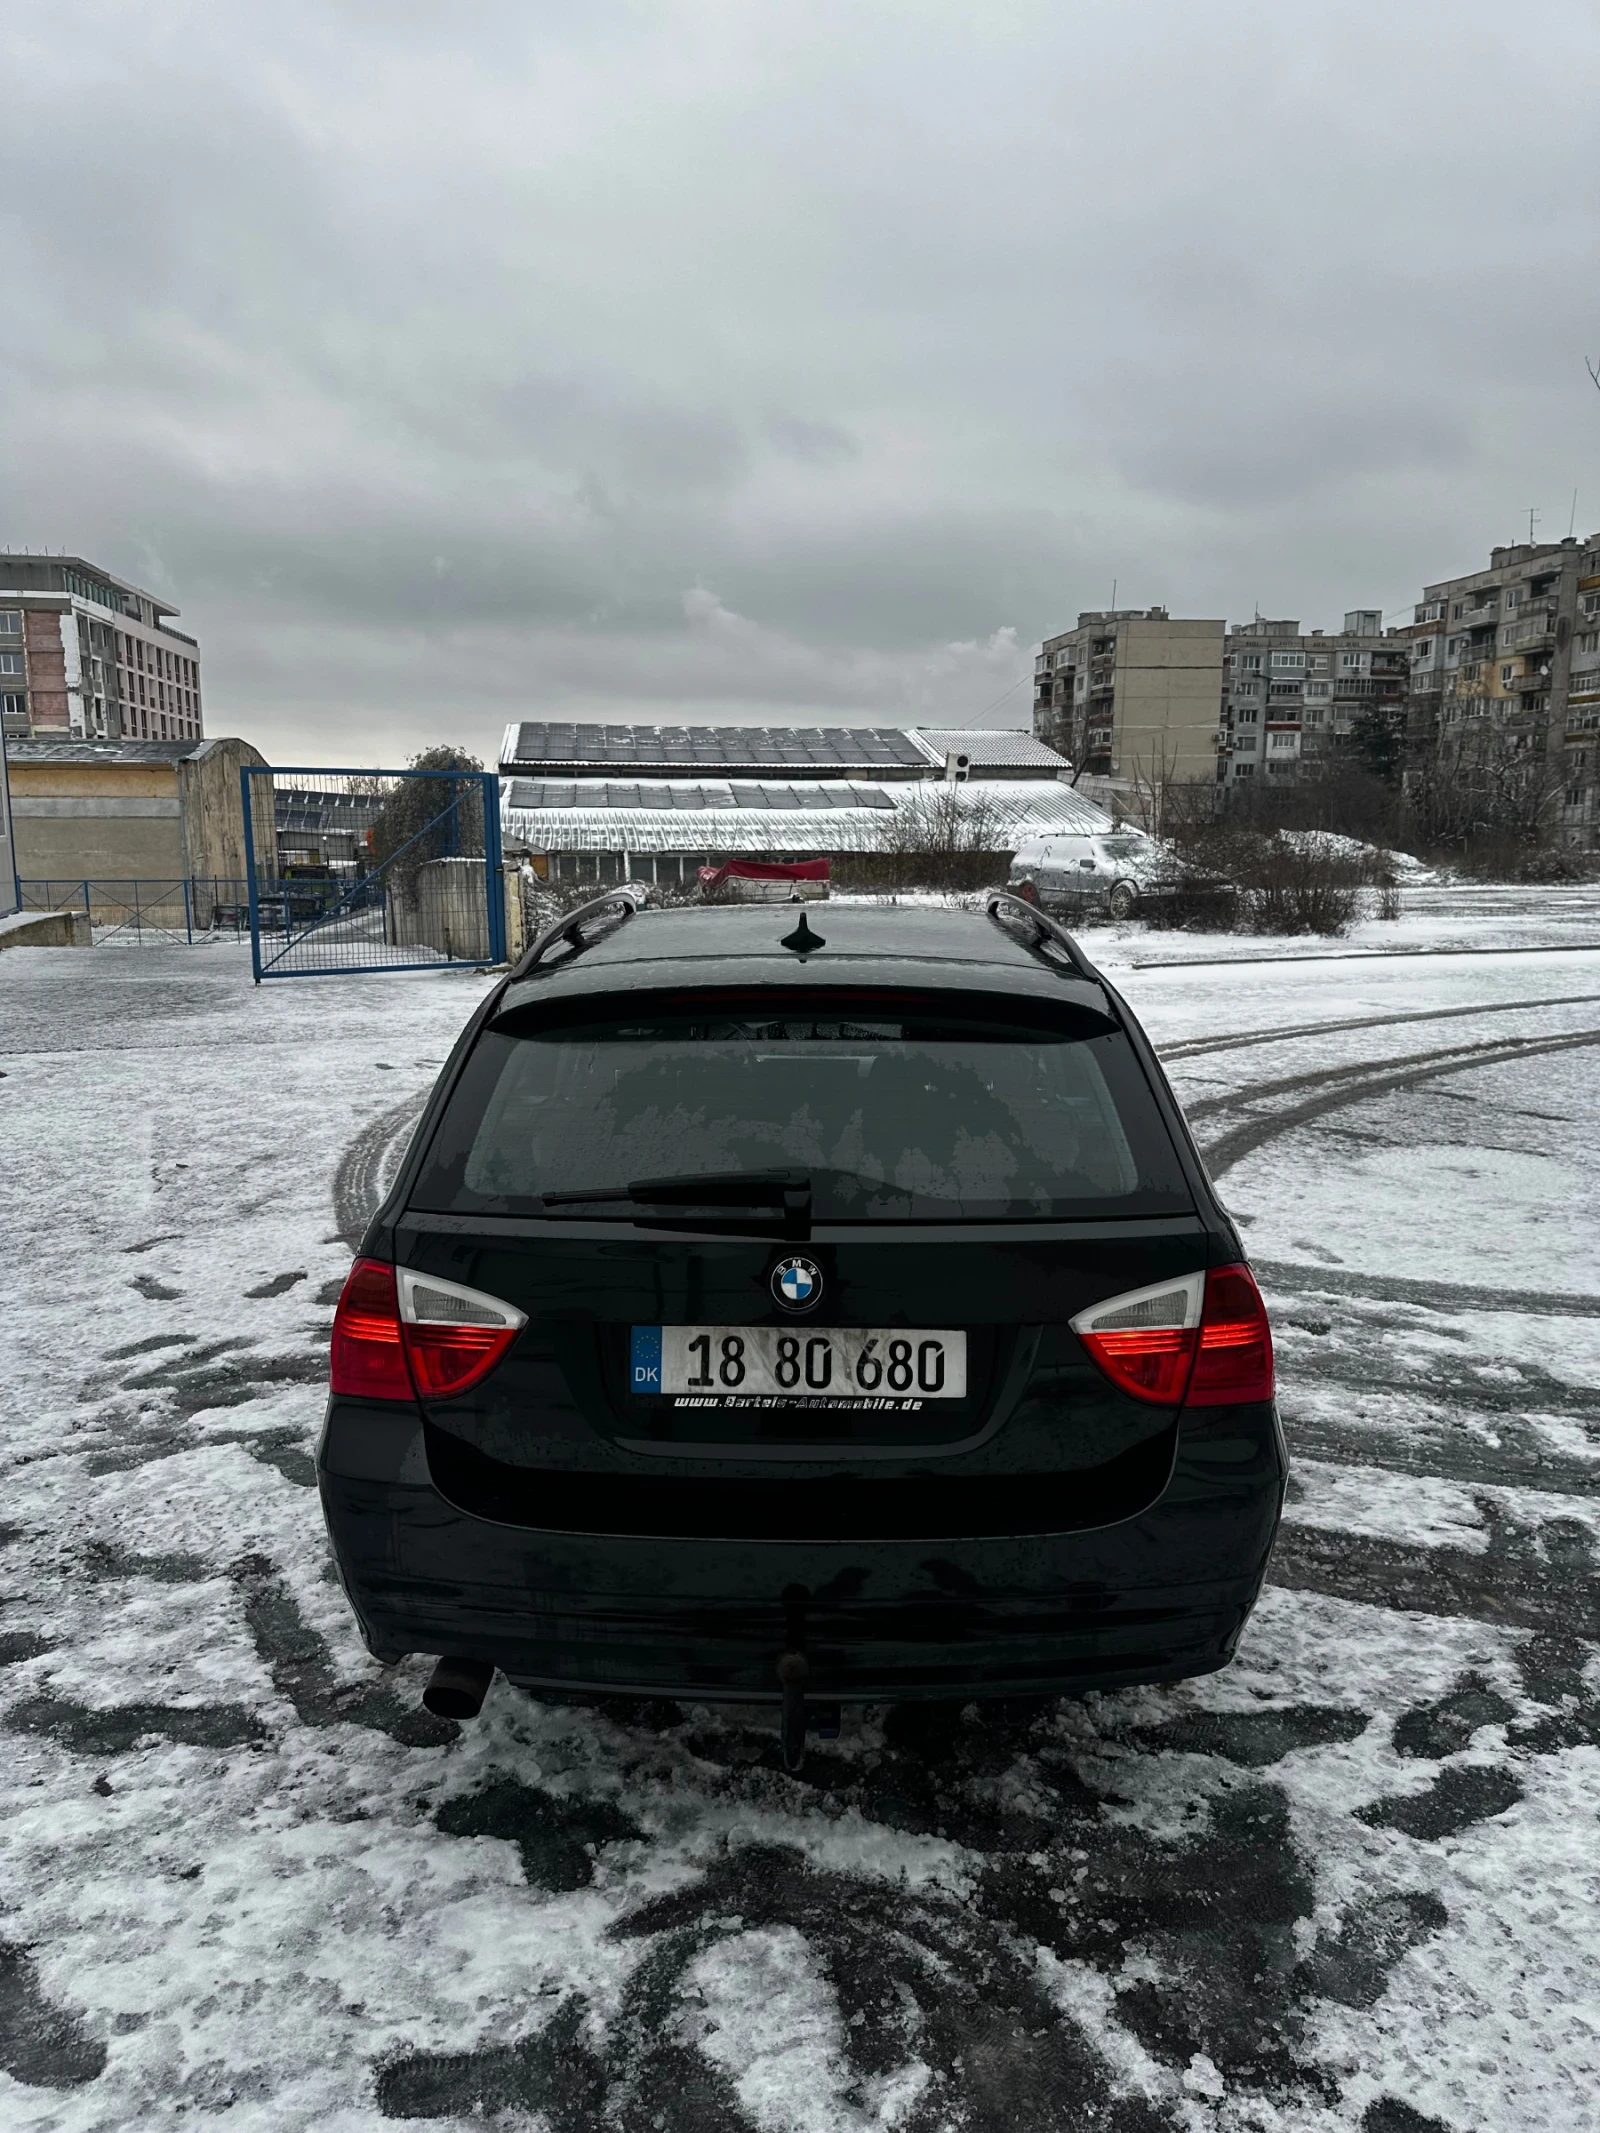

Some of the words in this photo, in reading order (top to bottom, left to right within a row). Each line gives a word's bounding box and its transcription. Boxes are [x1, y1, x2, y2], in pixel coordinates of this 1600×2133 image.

[777, 1259, 818, 1276] BMW
[688, 1334, 746, 1387] 18
[775, 1336, 832, 1389] 80
[856, 1339, 945, 1393] 680
[635, 1367, 658, 1381] DK
